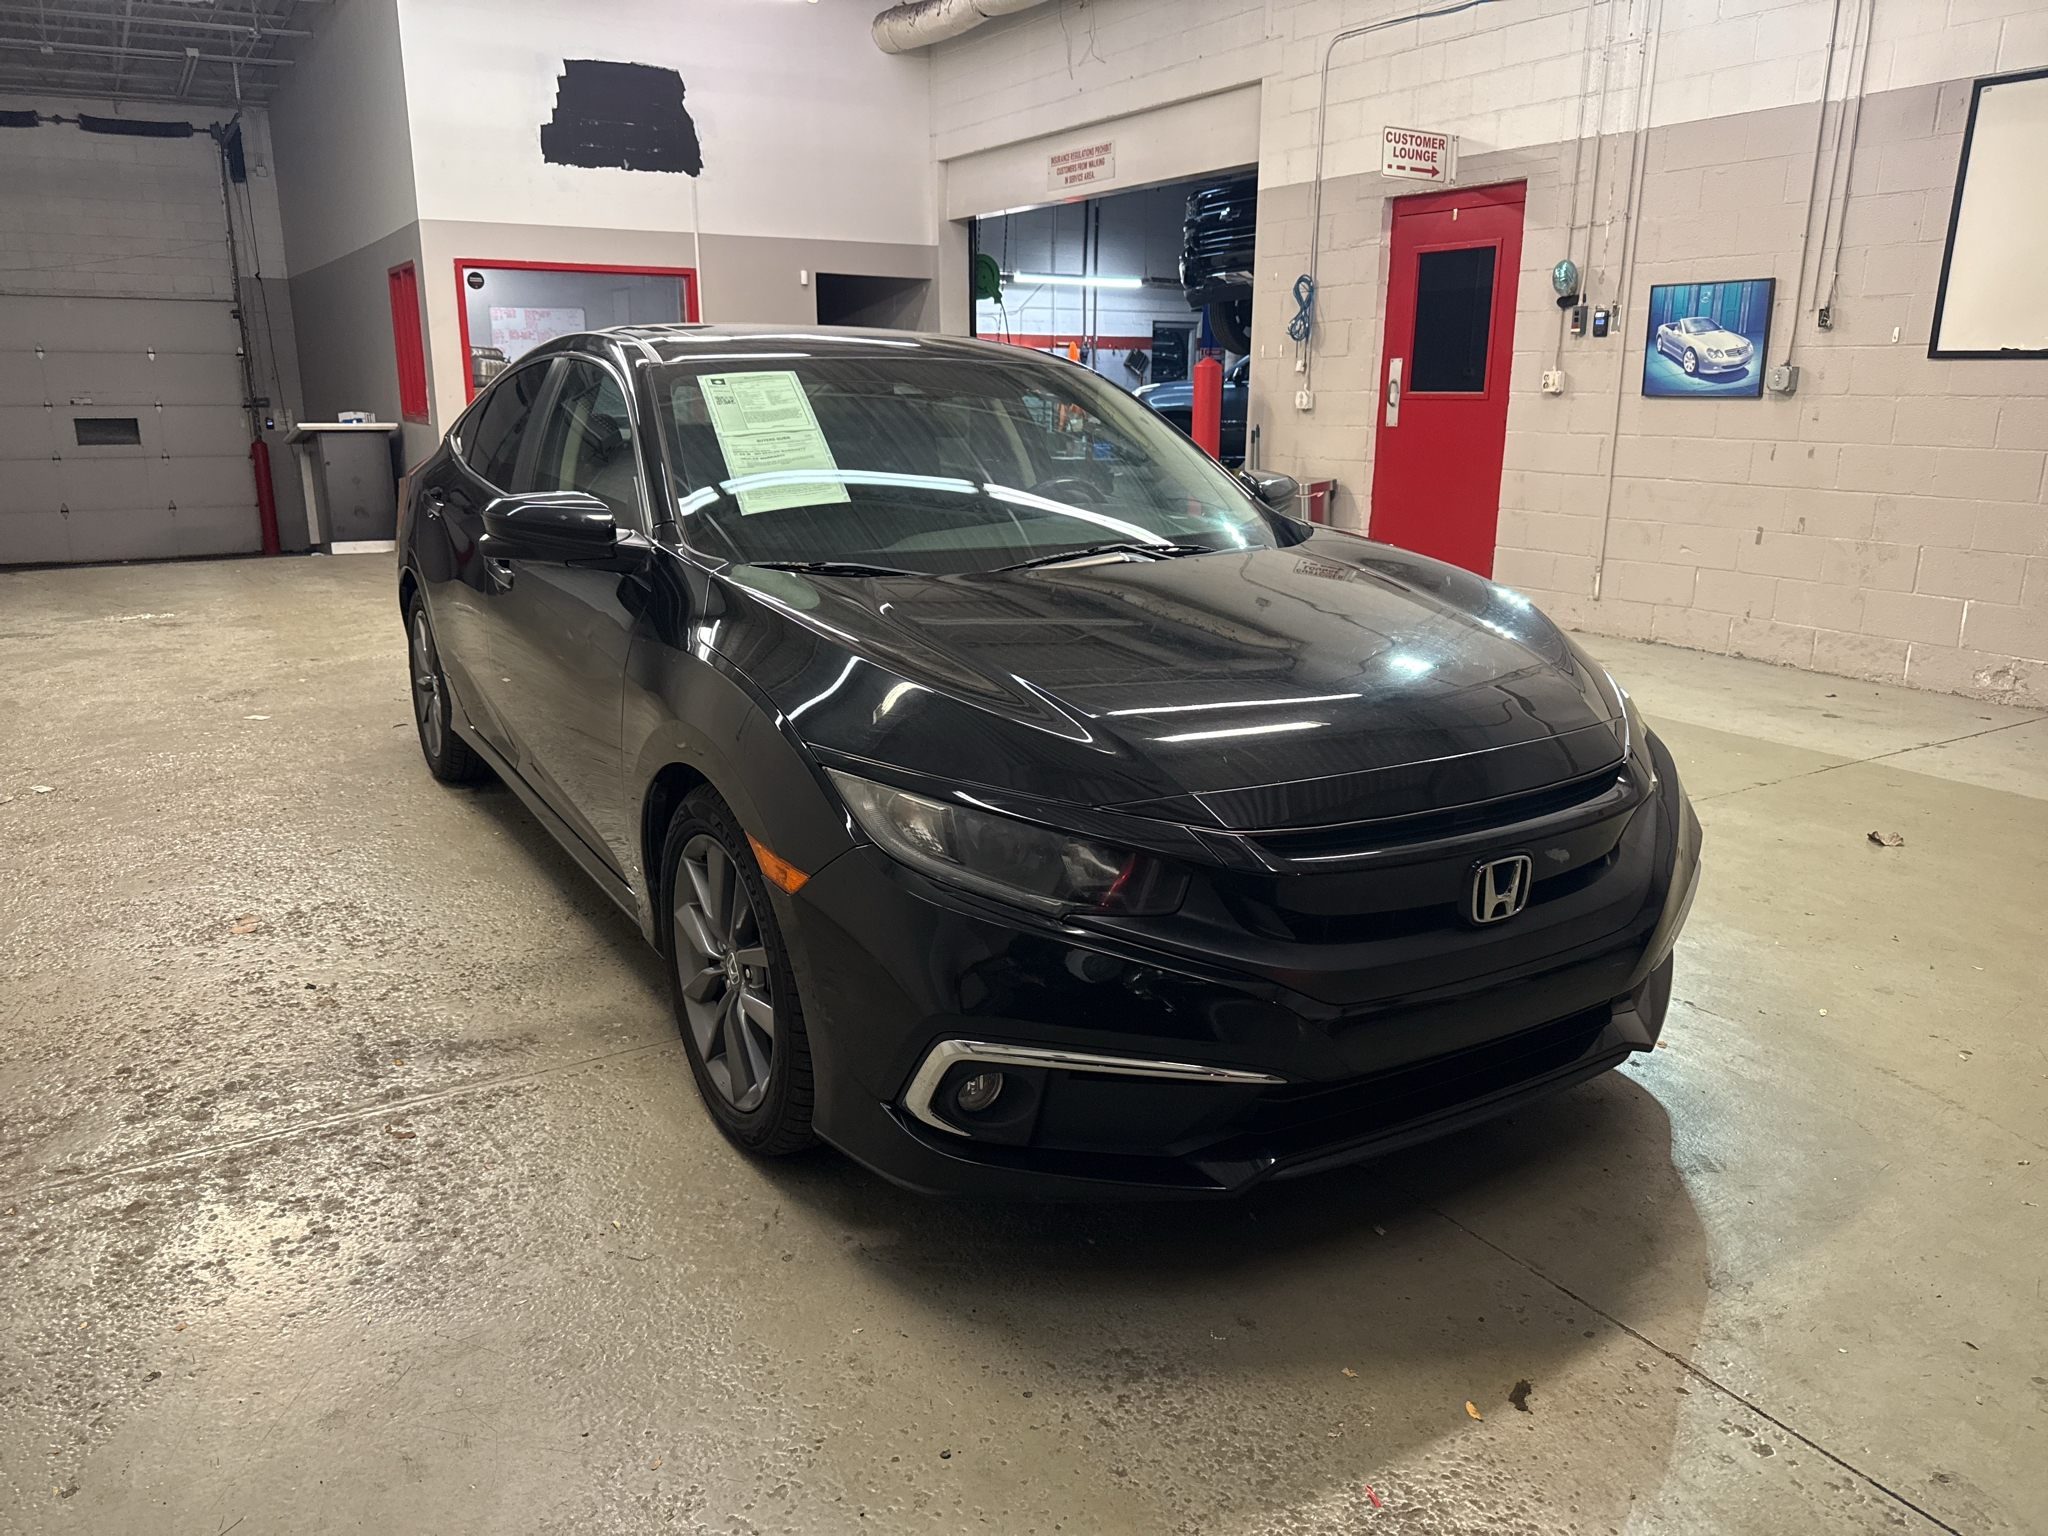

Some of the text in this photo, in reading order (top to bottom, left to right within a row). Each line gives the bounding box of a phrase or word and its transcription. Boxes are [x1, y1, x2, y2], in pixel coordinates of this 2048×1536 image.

[1385, 131, 1445, 150] CUSTOMER
[1051, 142, 1112, 165] INSURANCE REGULATIONS PROHIBIT
[1393, 146, 1437, 163] LOUNGE
[1056, 157, 1105, 176] CUSTOMERS FROM WALKING
[1069, 173, 1083, 184] SERVICE
